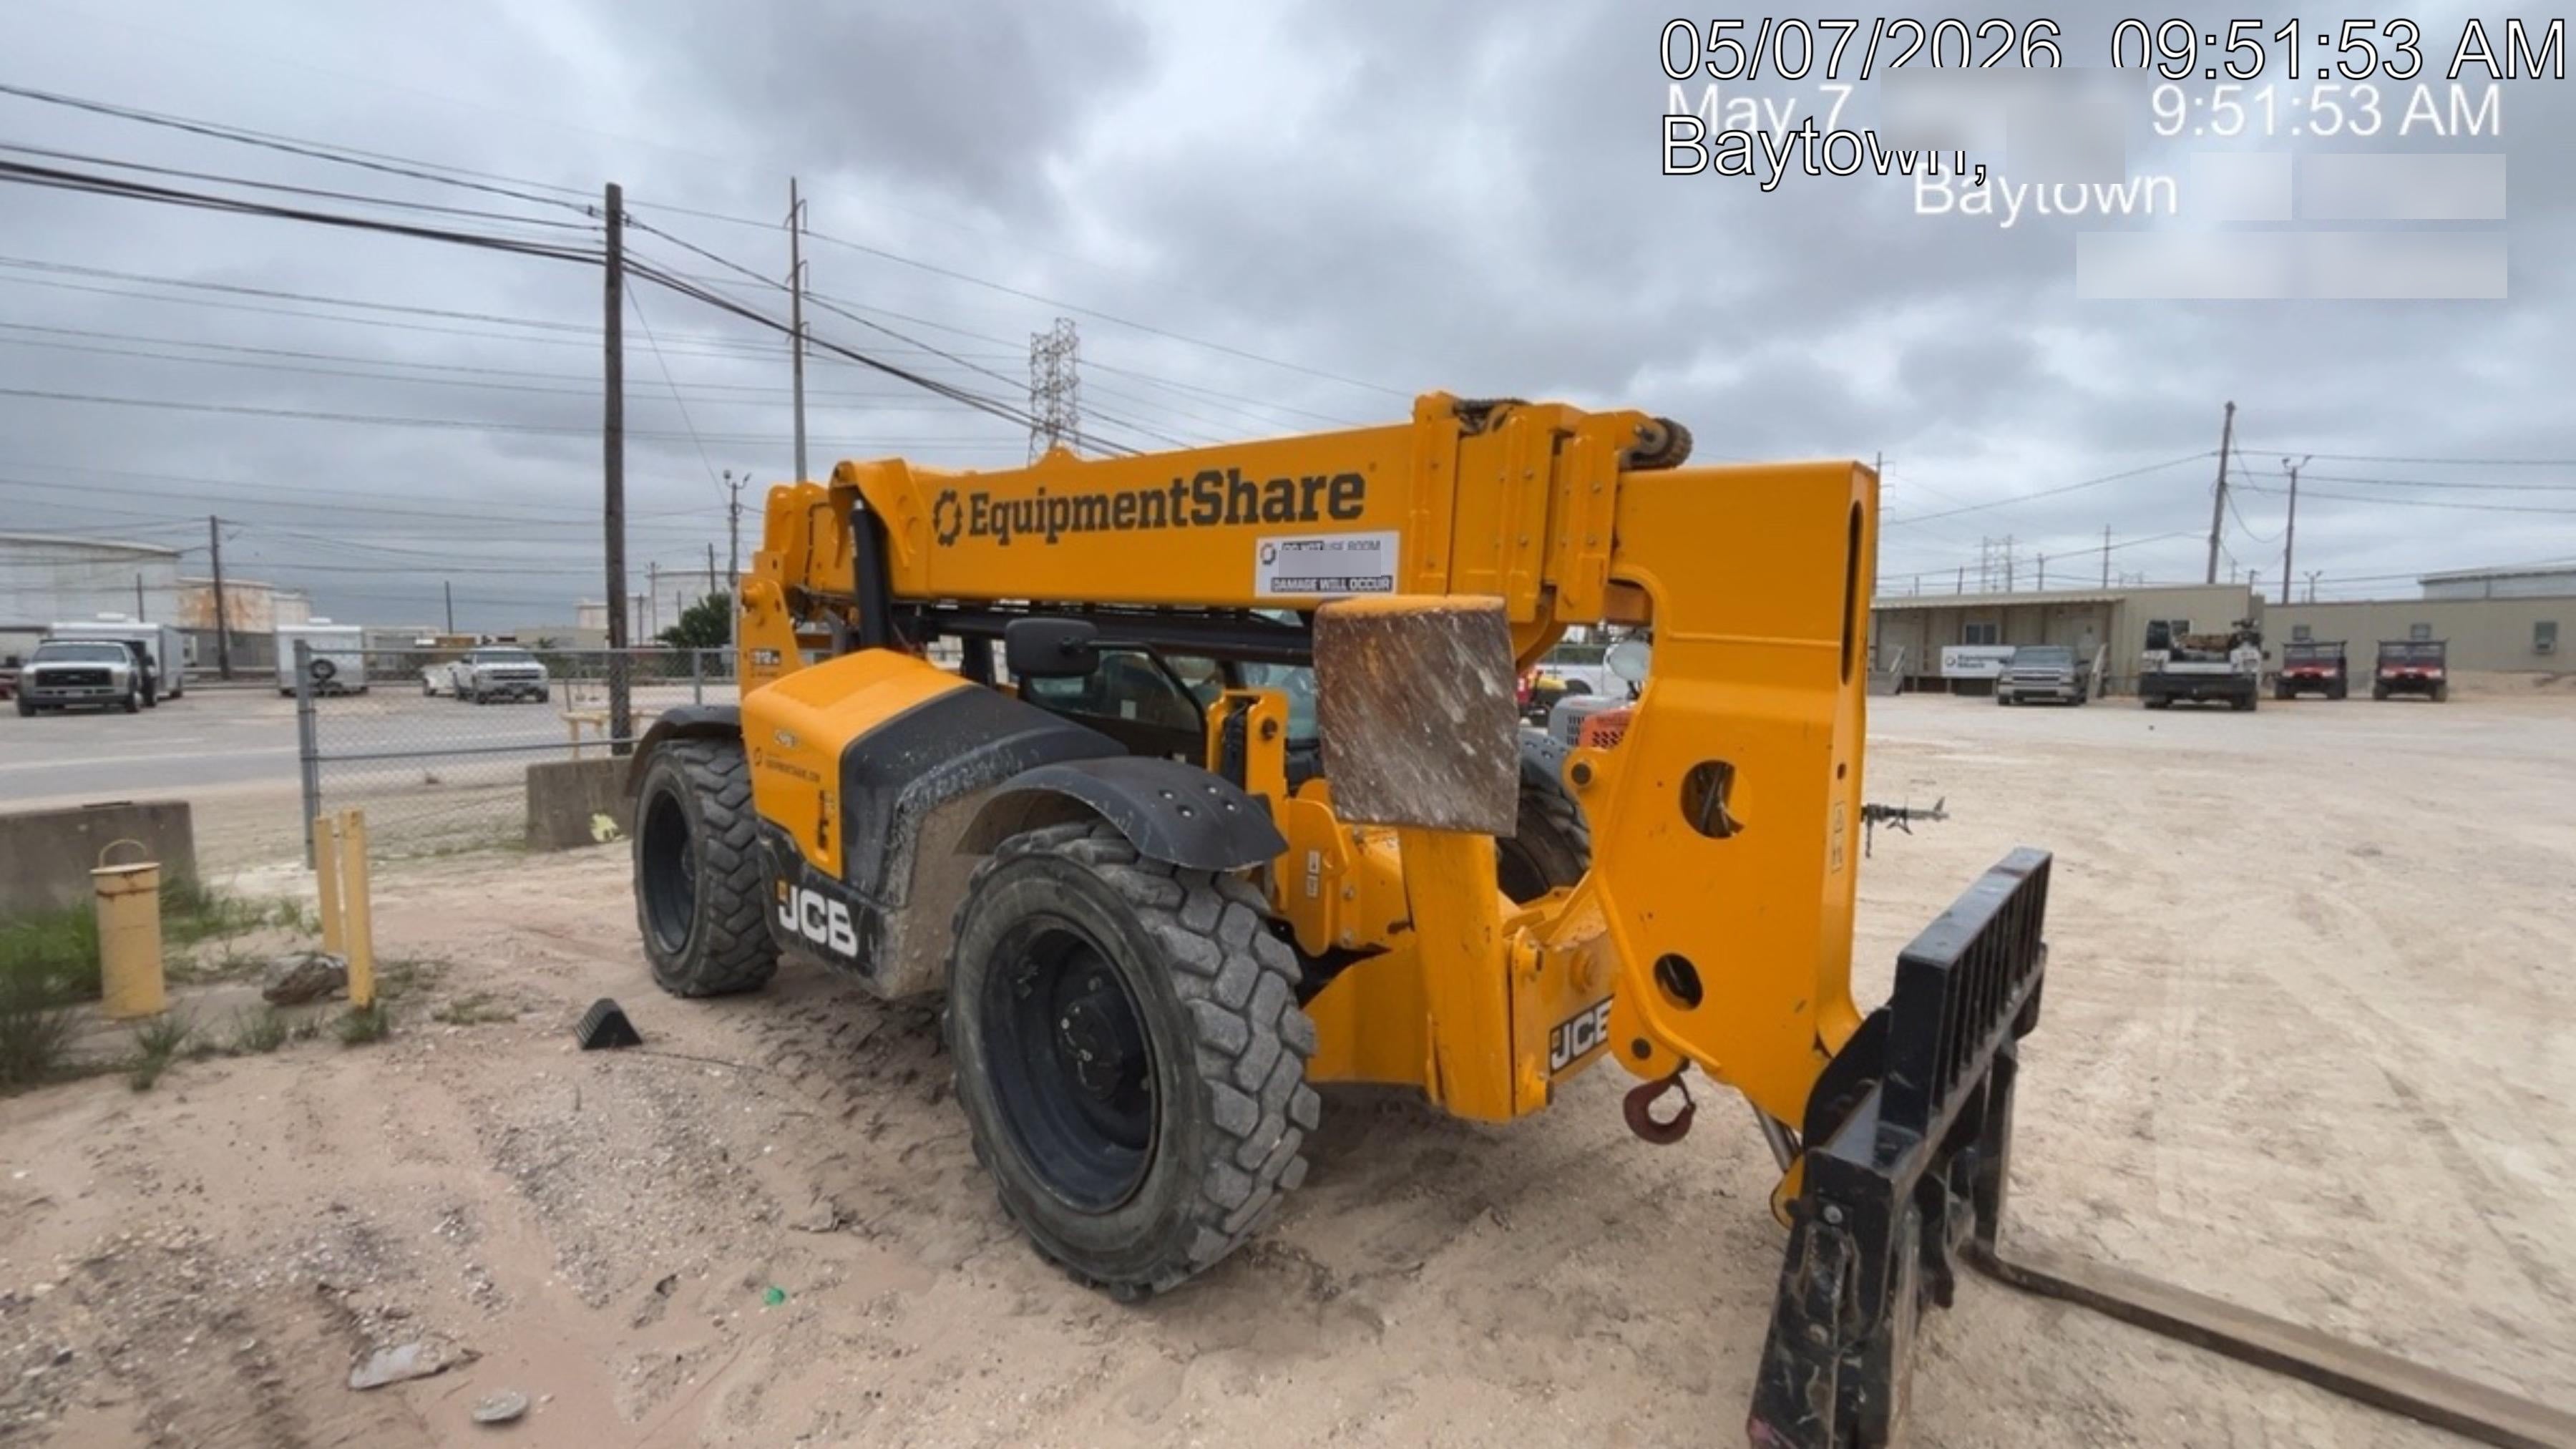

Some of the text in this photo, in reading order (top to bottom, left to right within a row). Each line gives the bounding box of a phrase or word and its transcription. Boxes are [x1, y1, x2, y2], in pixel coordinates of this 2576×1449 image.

[969, 468, 1366, 547] EquipmentShare
[1274, 578, 1390, 591] DAMAGE WILL OCCUR
[777, 883, 859, 958] JCB
